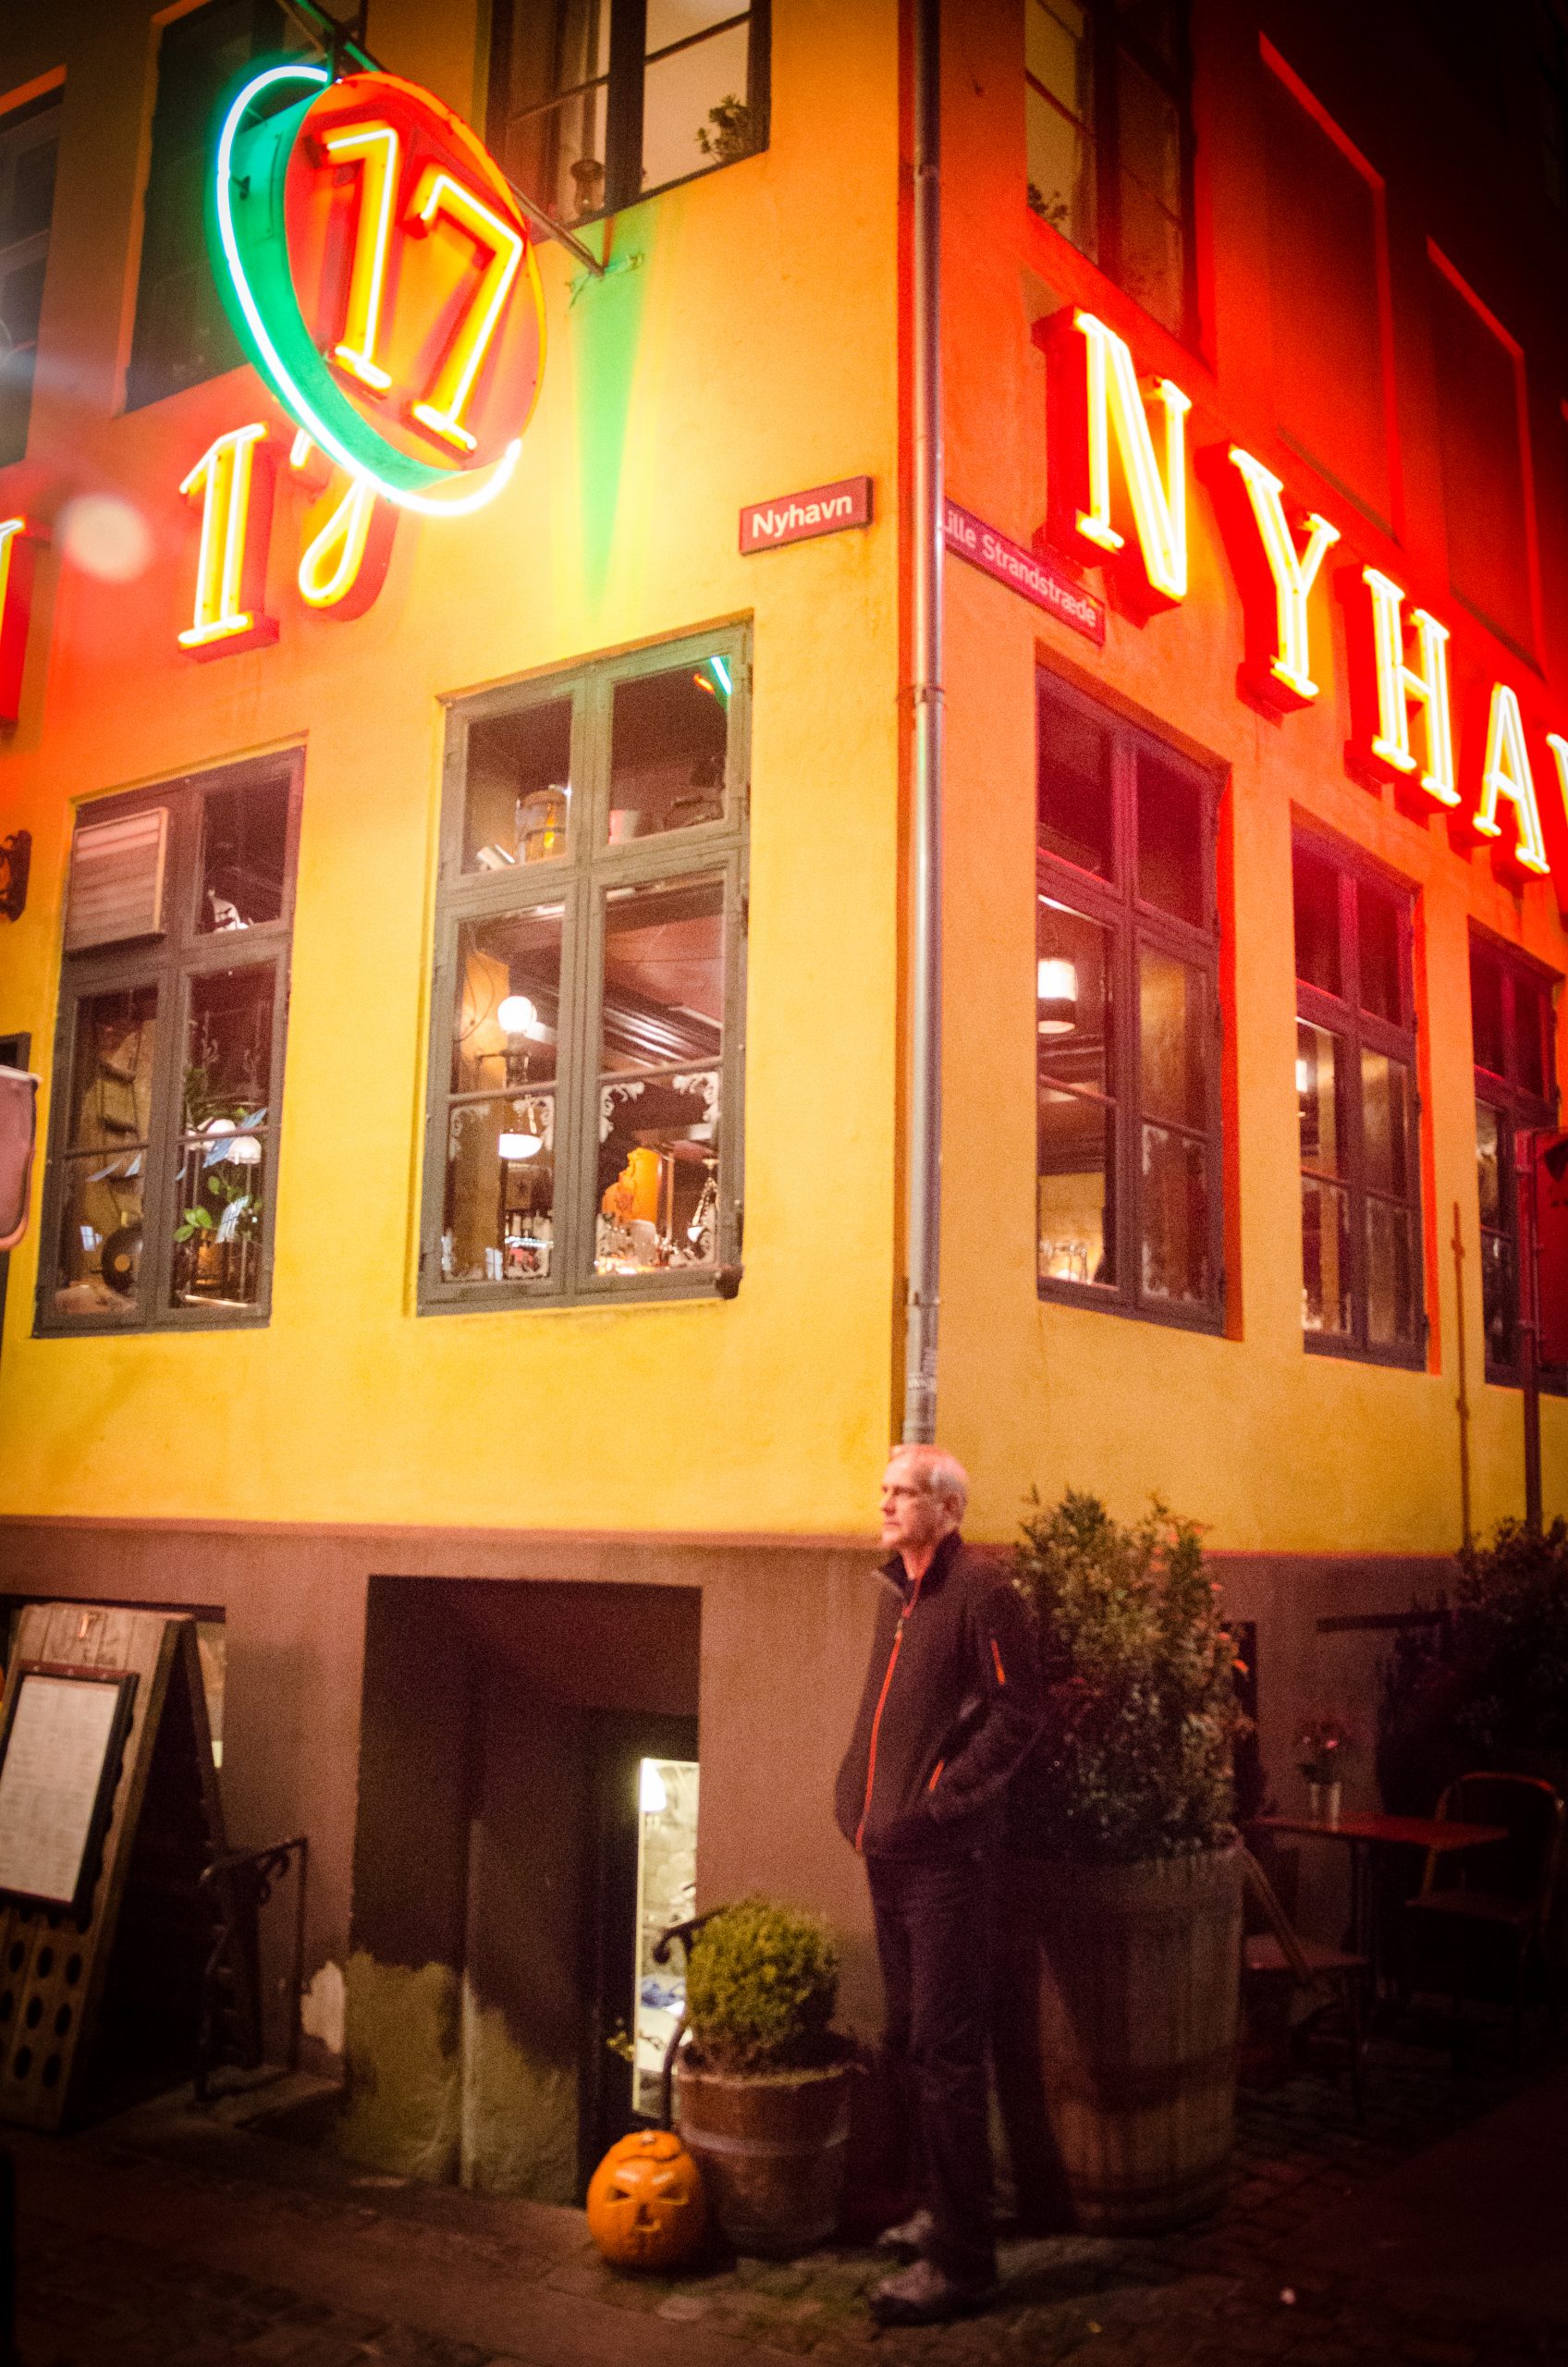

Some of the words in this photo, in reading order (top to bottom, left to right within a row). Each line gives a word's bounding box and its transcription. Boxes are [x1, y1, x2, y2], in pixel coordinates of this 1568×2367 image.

[323, 121, 523, 453] 17
[752, 496, 852, 538] Nyhavn
[982, 533, 1097, 628] Strandstræde
